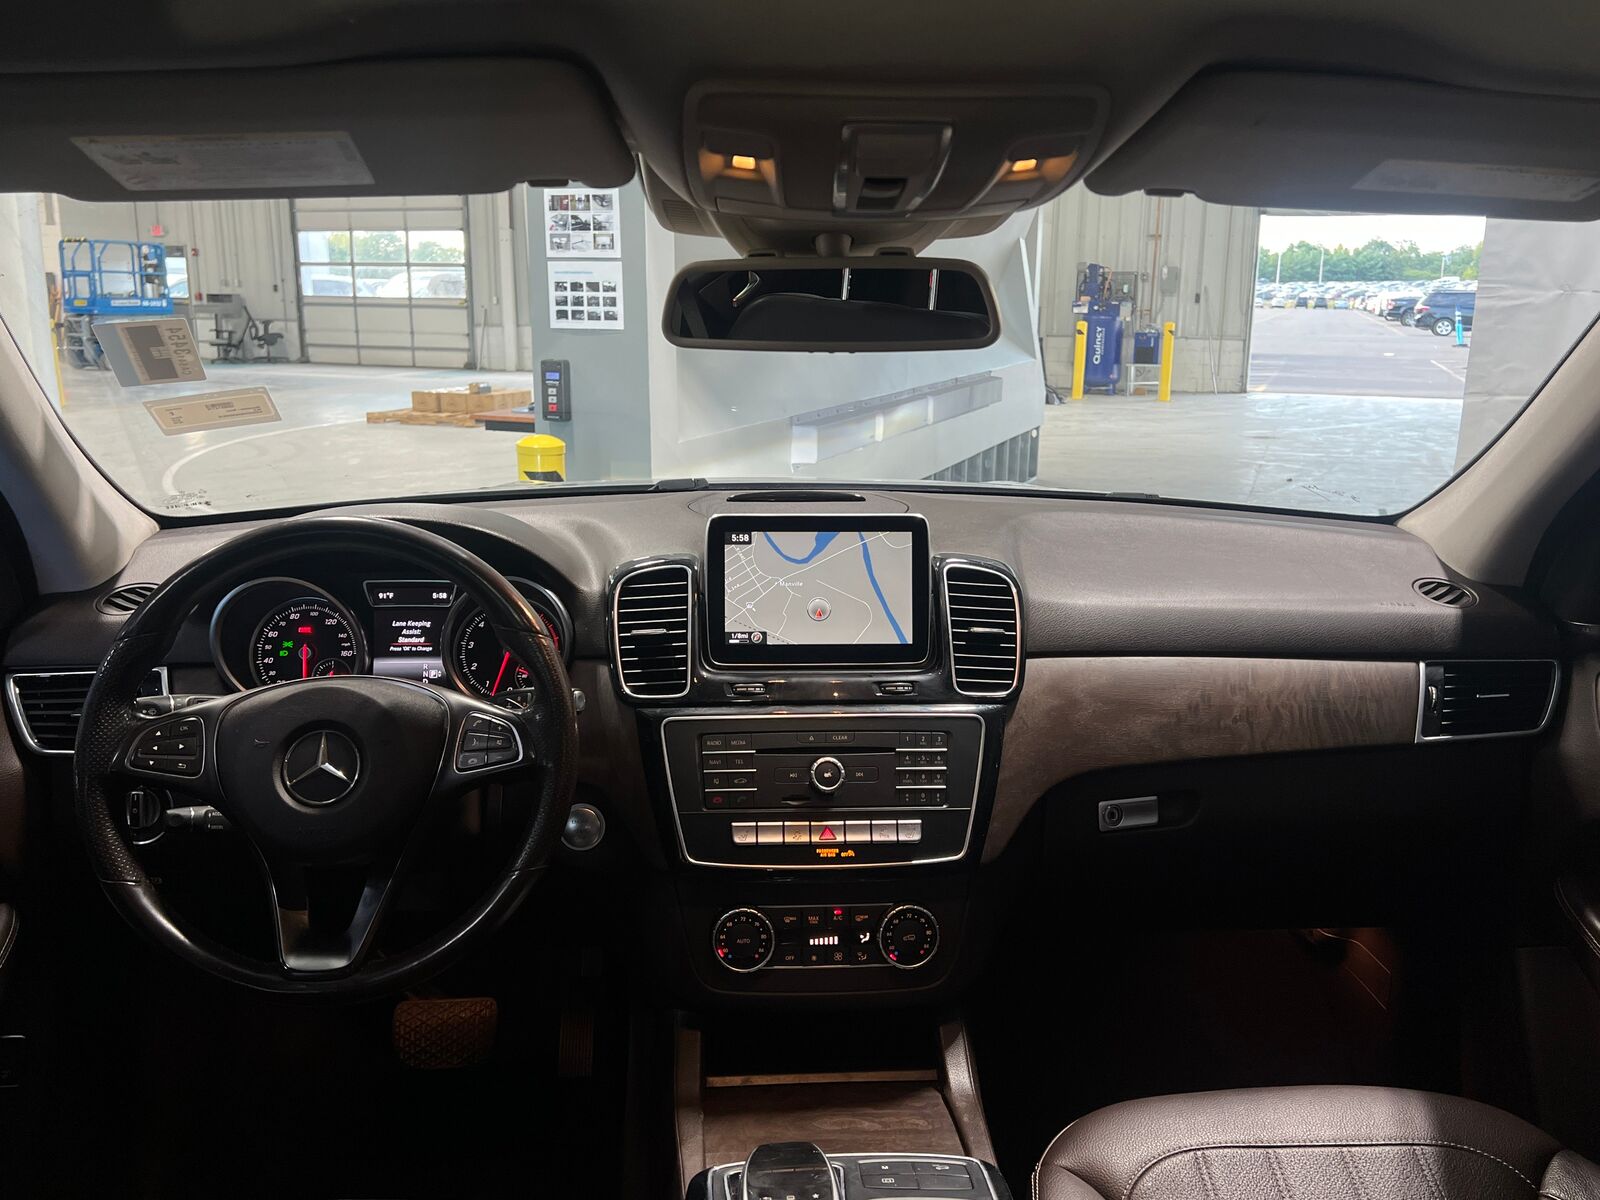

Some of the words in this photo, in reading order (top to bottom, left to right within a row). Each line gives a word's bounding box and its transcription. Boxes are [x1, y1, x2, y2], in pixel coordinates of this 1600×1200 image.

[1093, 326, 1102, 364] Quincy
[731, 534, 750, 542] 5:58
[407, 620, 431, 628] Keeping
[468, 641, 475, 649] 3
[470, 662, 478, 670] 2
